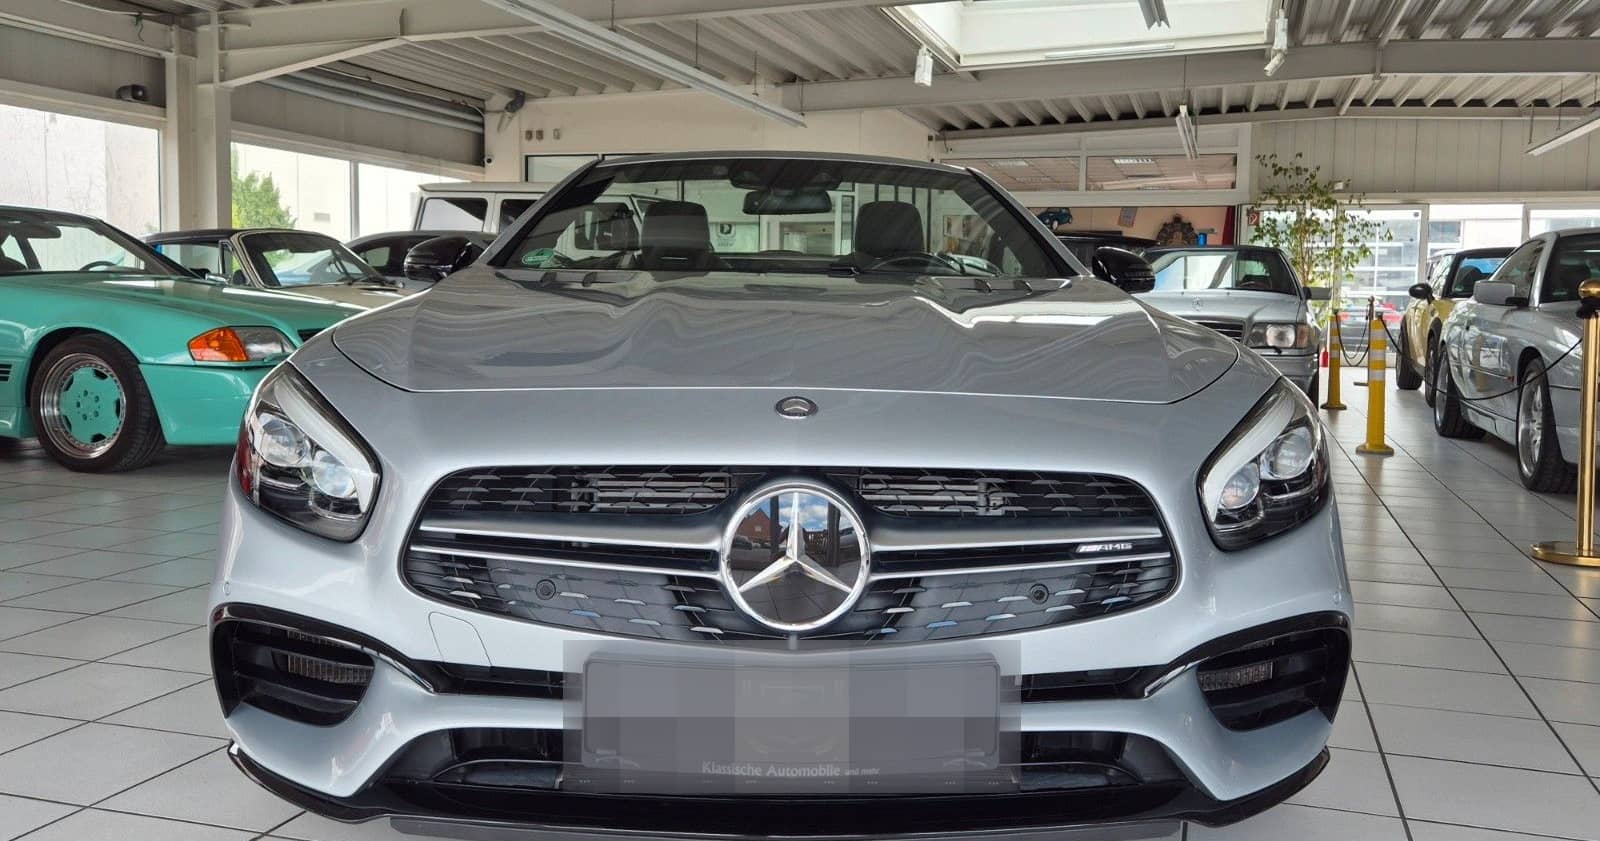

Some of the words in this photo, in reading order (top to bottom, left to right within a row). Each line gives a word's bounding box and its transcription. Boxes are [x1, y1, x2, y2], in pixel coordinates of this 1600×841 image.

[1095, 543, 1133, 552] AMG
[702, 760, 762, 776] Klassische
[766, 763, 841, 777] Automobile
